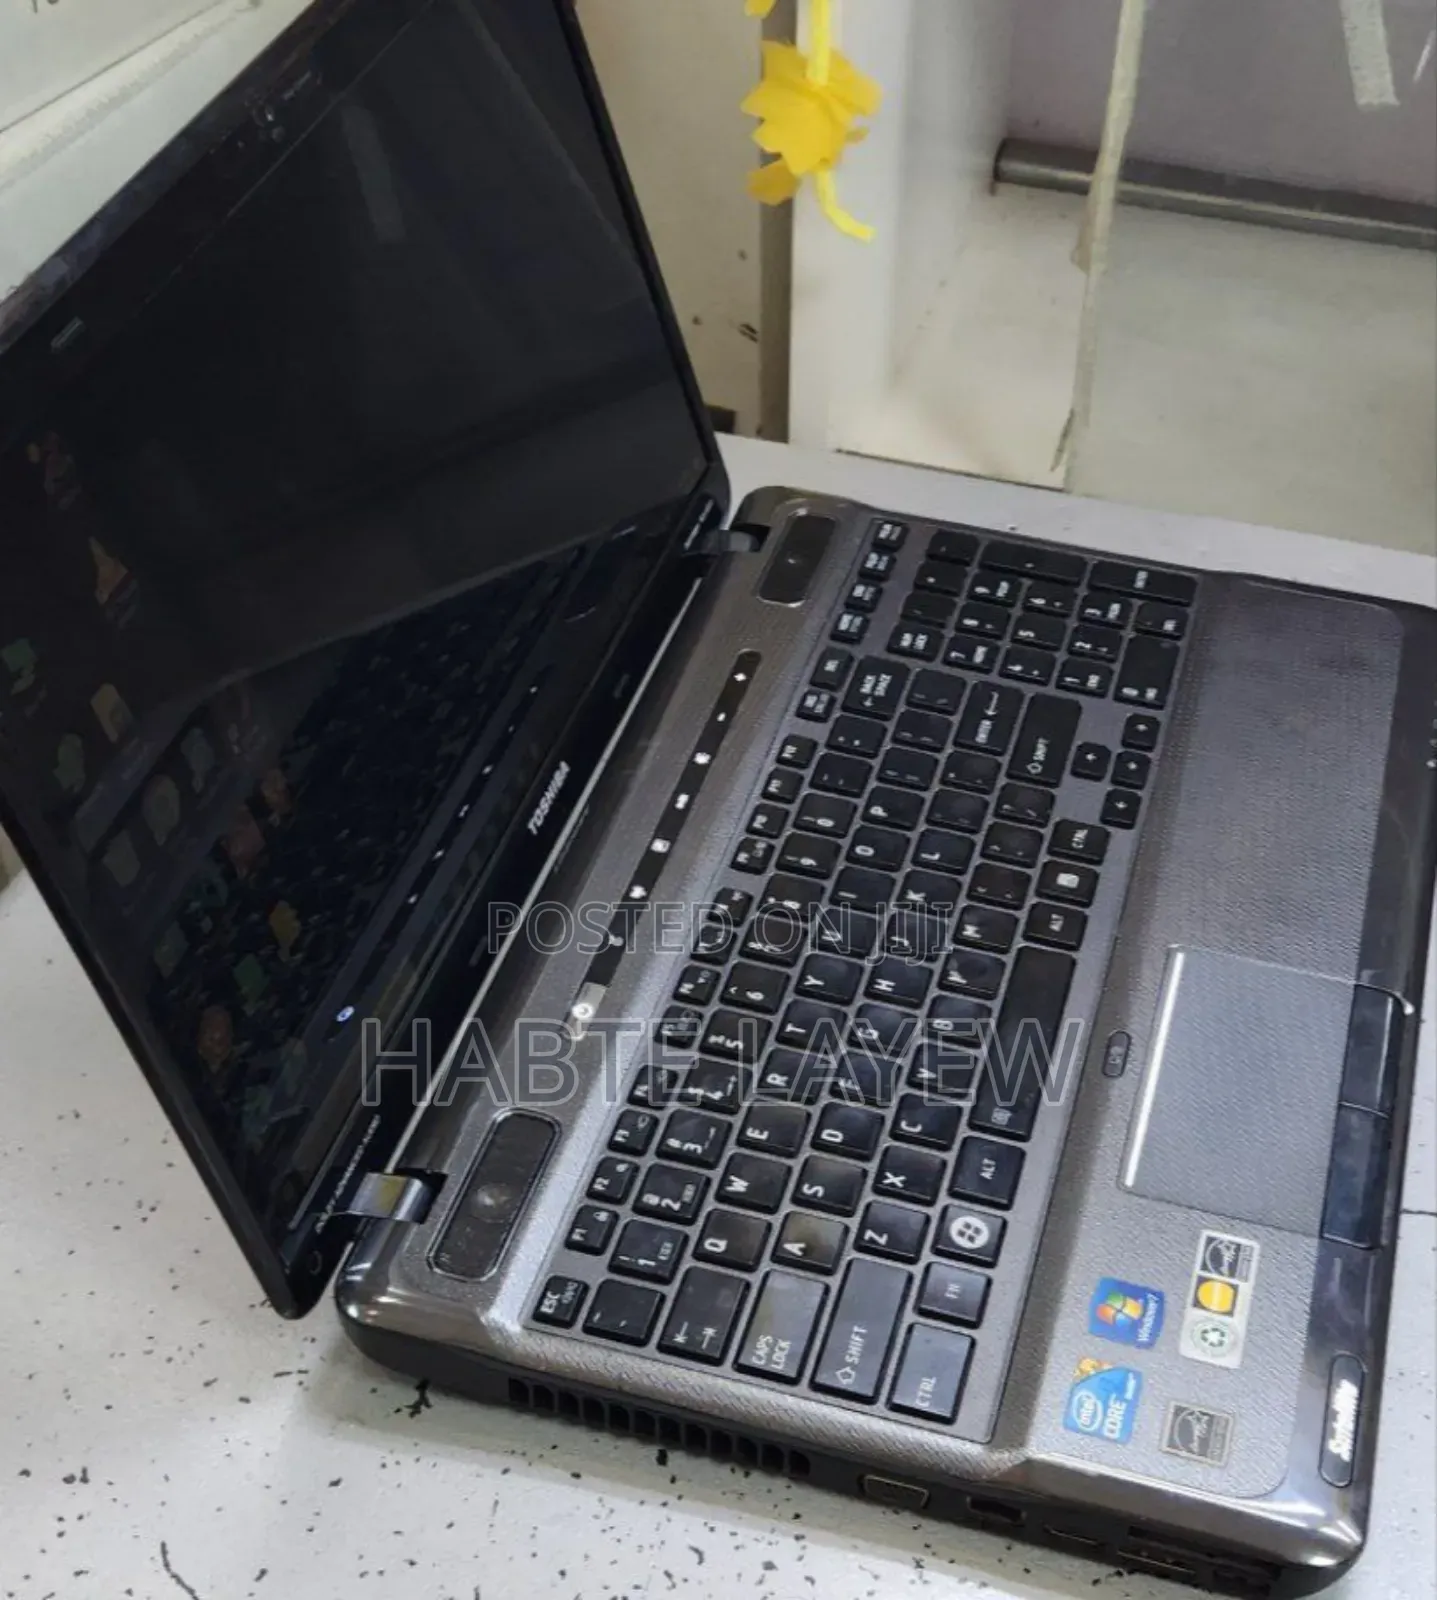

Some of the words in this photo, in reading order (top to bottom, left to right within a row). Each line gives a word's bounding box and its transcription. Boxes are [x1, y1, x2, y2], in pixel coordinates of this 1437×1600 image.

[1033, 739, 1049, 763] SHIFT
[527, 760, 570, 836] TOSHIBA
[869, 805, 888, 818] P
[855, 845, 875, 856] O
[962, 924, 982, 938] M
[804, 974, 826, 988] Y
[874, 978, 895, 992] H
[786, 1023, 806, 1035] T
[933, 1019, 953, 1031] B
[767, 1072, 788, 1087] R
[917, 1068, 936, 1080] V
[839, 1076, 859, 1090] F
[747, 1127, 768, 1141] E
[900, 1120, 922, 1133] C
[821, 1128, 843, 1142] D
[981, 1159, 995, 1180] ALT
[725, 1175, 749, 1192] W
[881, 1172, 906, 1189] X
[803, 1183, 824, 1196] S
[865, 1229, 888, 1245] Z
[704, 1237, 727, 1253] Q
[784, 1241, 806, 1256] A
[946, 1283, 959, 1300] FN
[541, 1291, 559, 1314] ESC
[752, 1335, 773, 1366] CAPS
[846, 1326, 868, 1364] SHIFT
[772, 1339, 792, 1370] LOCK
[918, 1377, 935, 1407] CTRL
